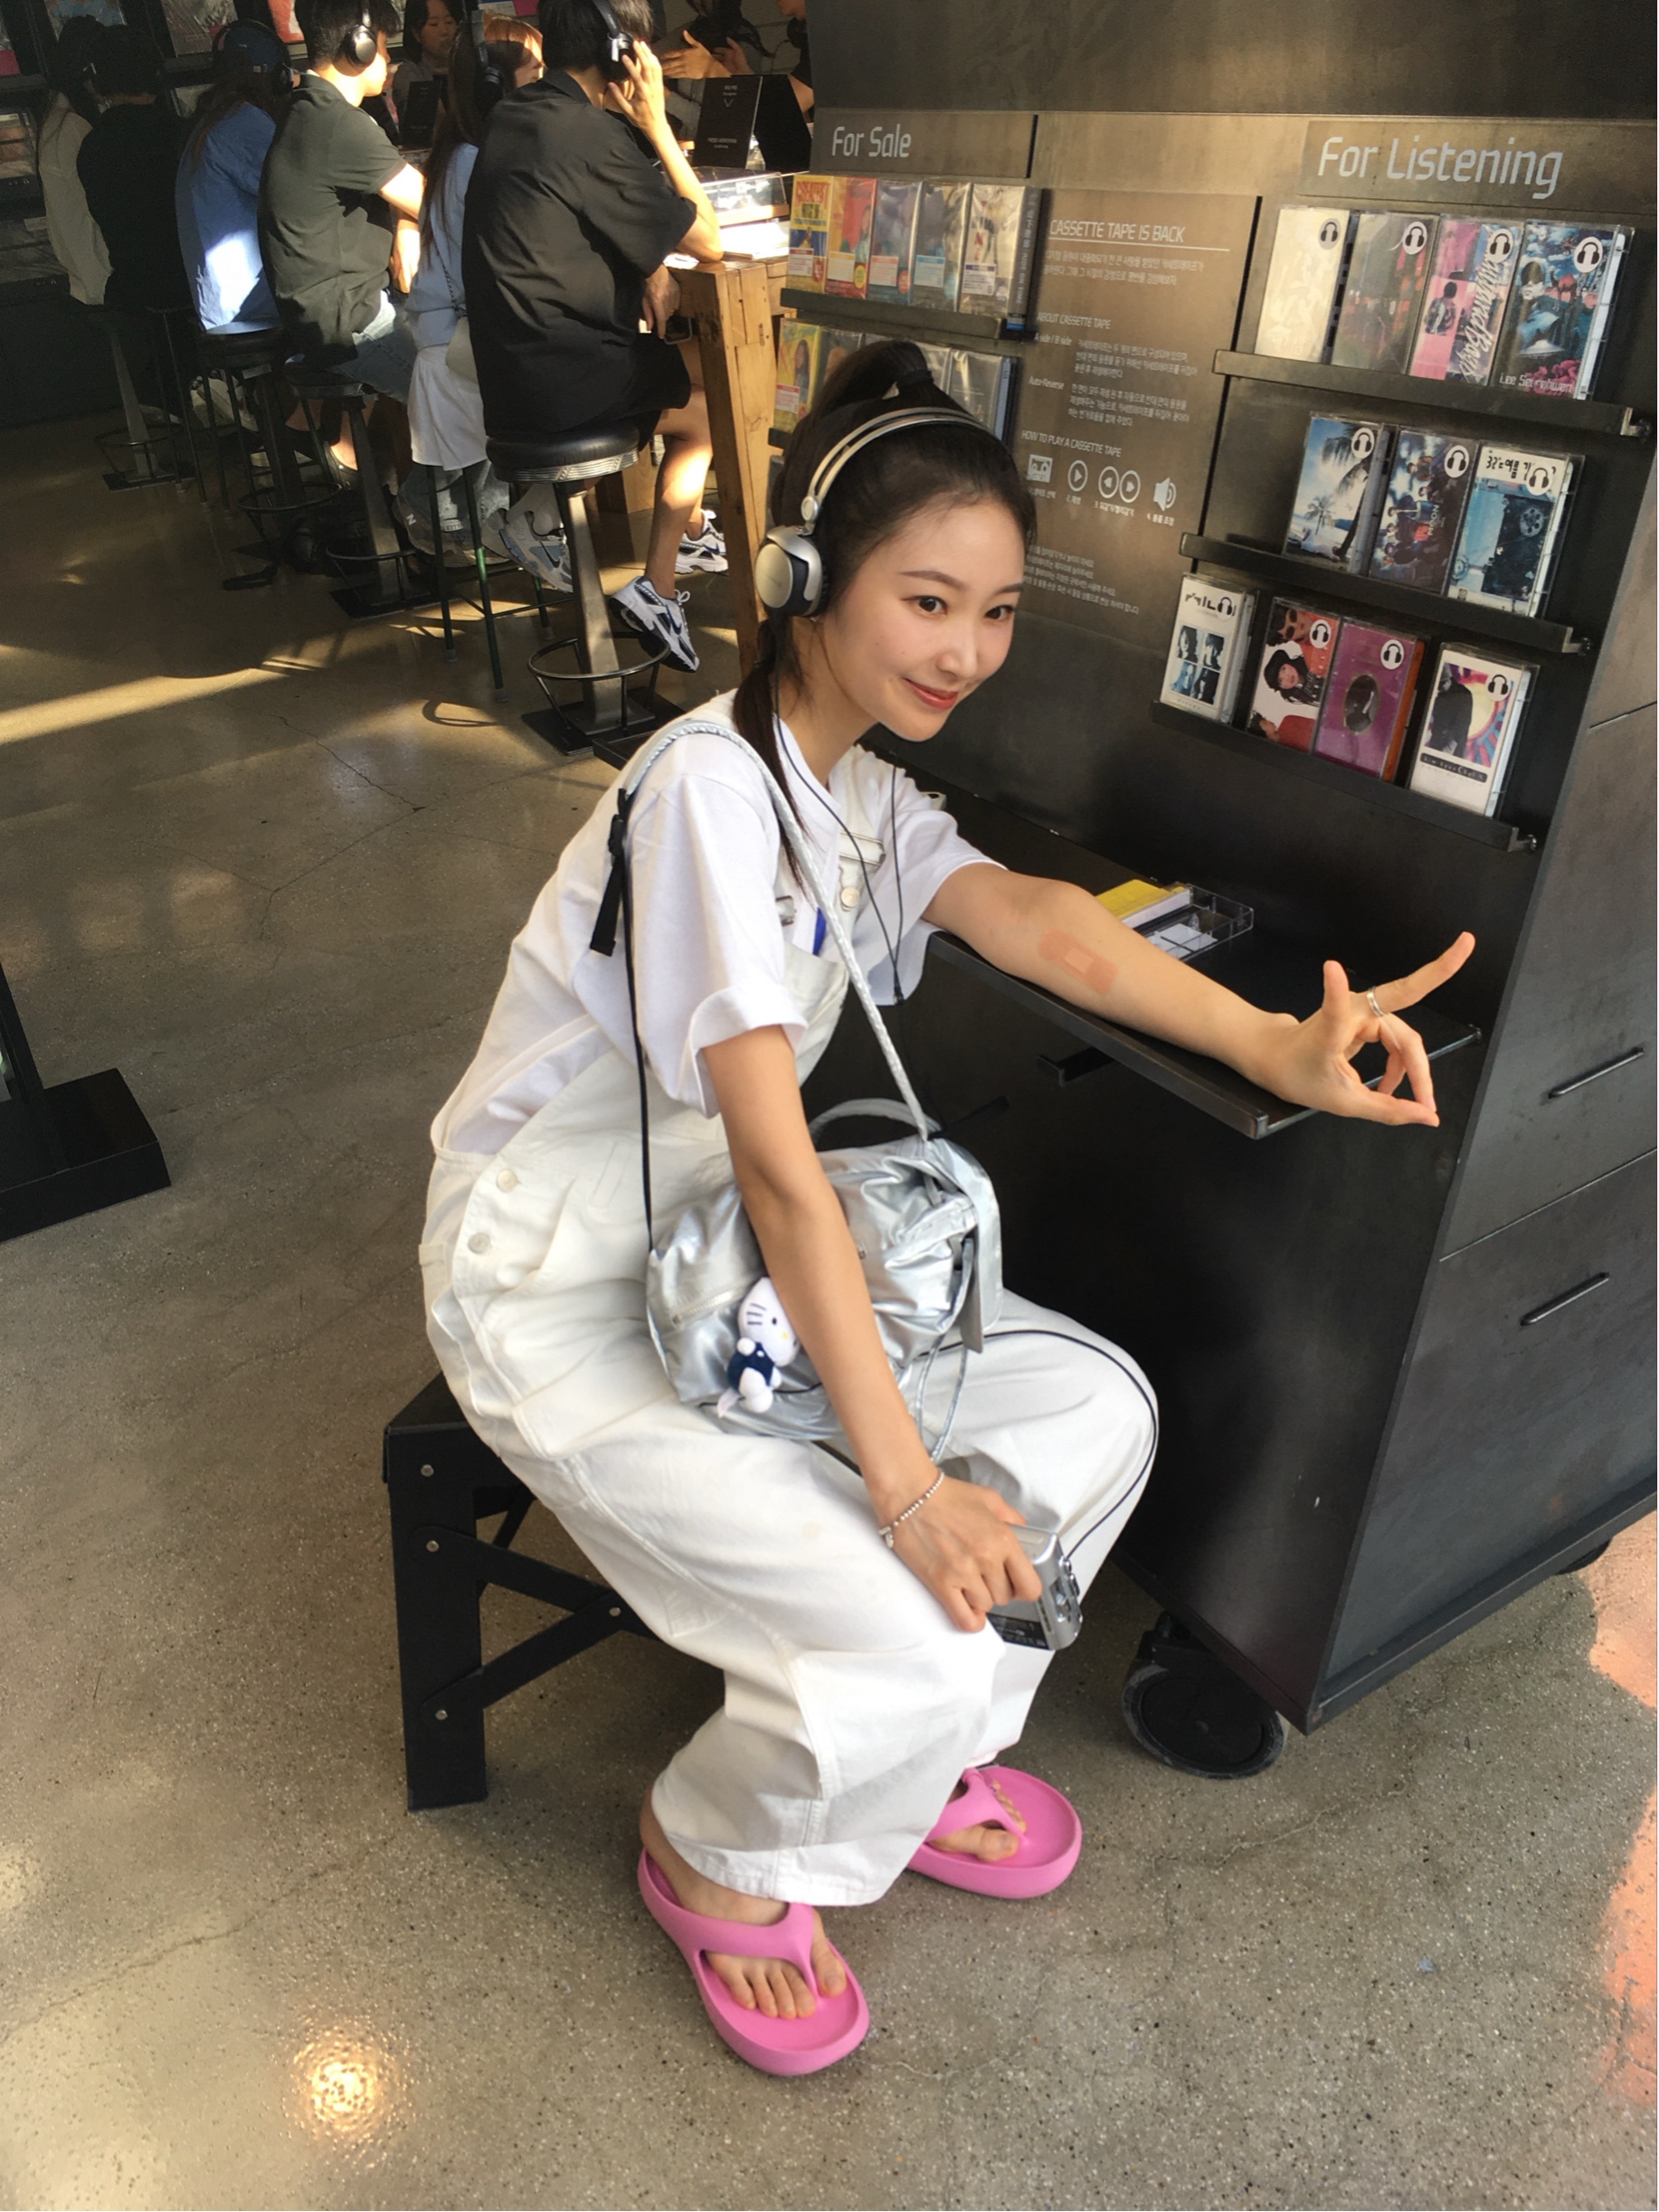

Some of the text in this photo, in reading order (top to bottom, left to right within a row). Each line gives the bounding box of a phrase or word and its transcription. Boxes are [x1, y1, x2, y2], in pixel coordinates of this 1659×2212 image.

[832, 123, 912, 157] For Sale
[1318, 135, 1563, 200] For Listening
[1049, 220, 1105, 238] CASSETTE
[1107, 222, 1137, 240] TAPE
[1138, 224, 1151, 241] IS
[1152, 226, 1186, 243] BACK
[1037, 312, 1112, 330] ABOUT CASSETTE TAPE
[1499, 373, 1517, 385] Lee
[1021, 430, 1122, 458] HOW TO PLAY A CASSETTE TAPE
[406, 514, 417, 525] N
[1427, 504, 1440, 536] MOON
